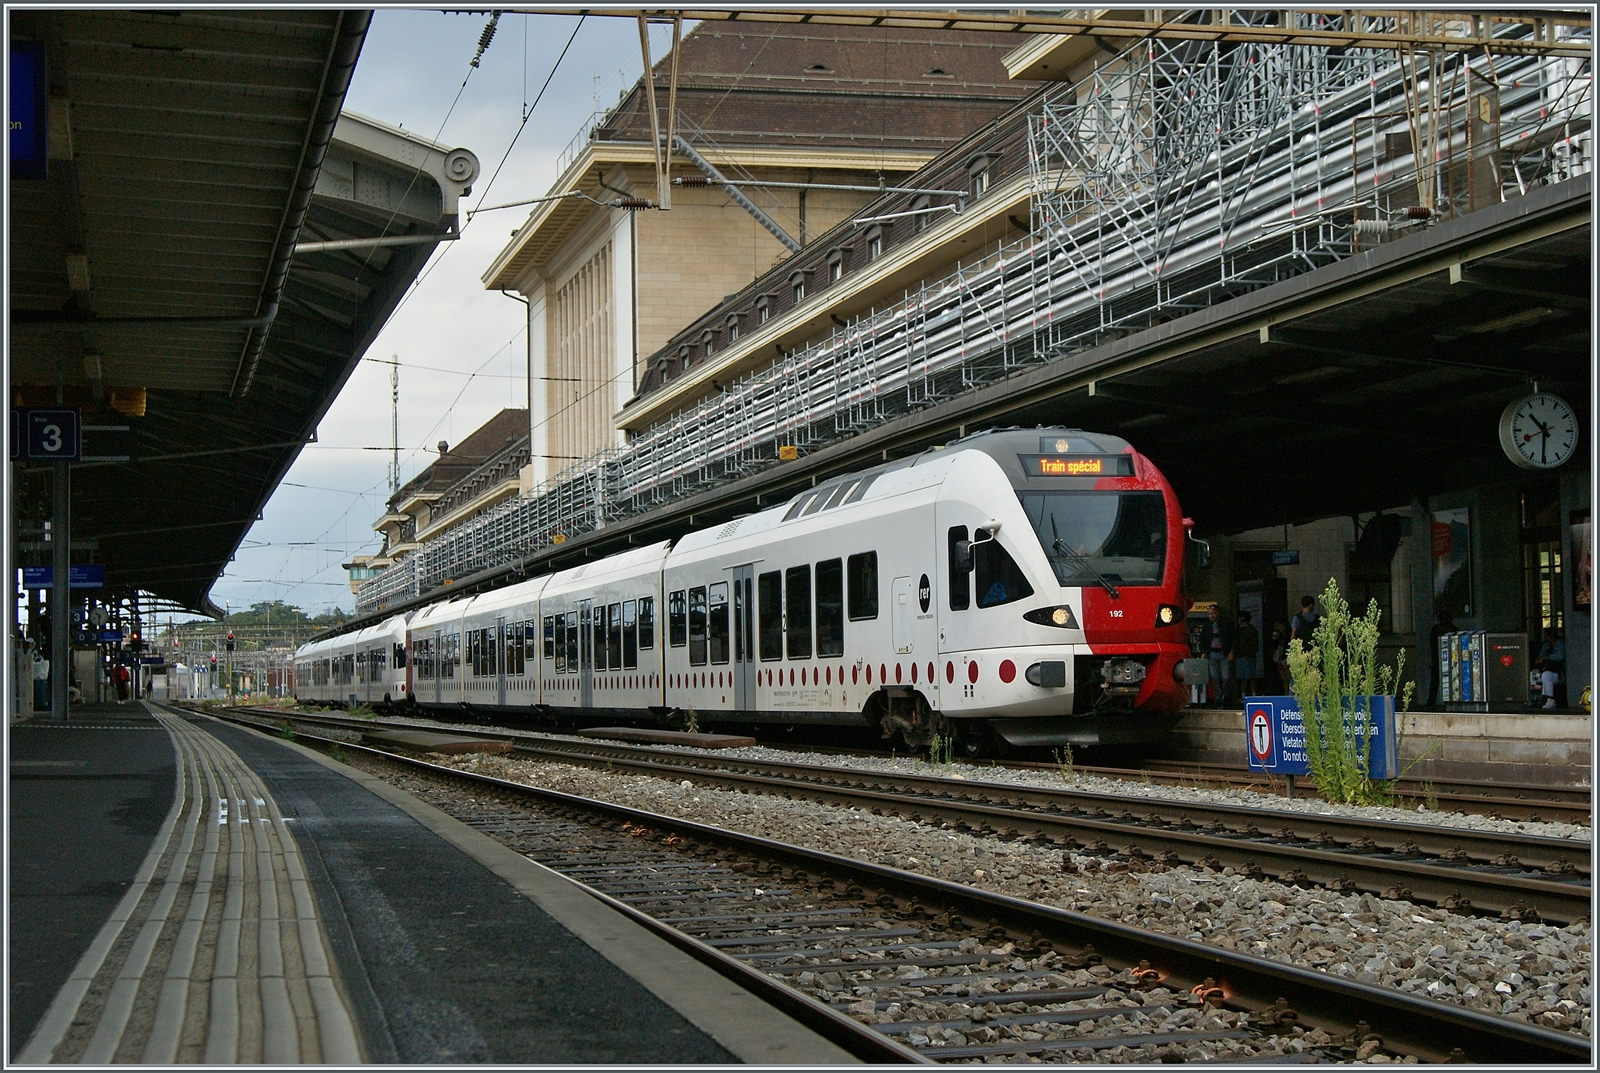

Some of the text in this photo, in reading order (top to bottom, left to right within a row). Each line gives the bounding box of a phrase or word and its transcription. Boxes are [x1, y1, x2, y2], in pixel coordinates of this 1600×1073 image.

[42, 424, 62, 452] 3
[1040, 459, 1101, 475] Train spécial
[919, 587, 930, 600] rer
[73, 613, 80, 622] 3
[1109, 610, 1123, 618] 192
[1281, 736, 1303, 748] Vietato
[1283, 751, 1292, 761] Do
[1292, 751, 1302, 762] not
